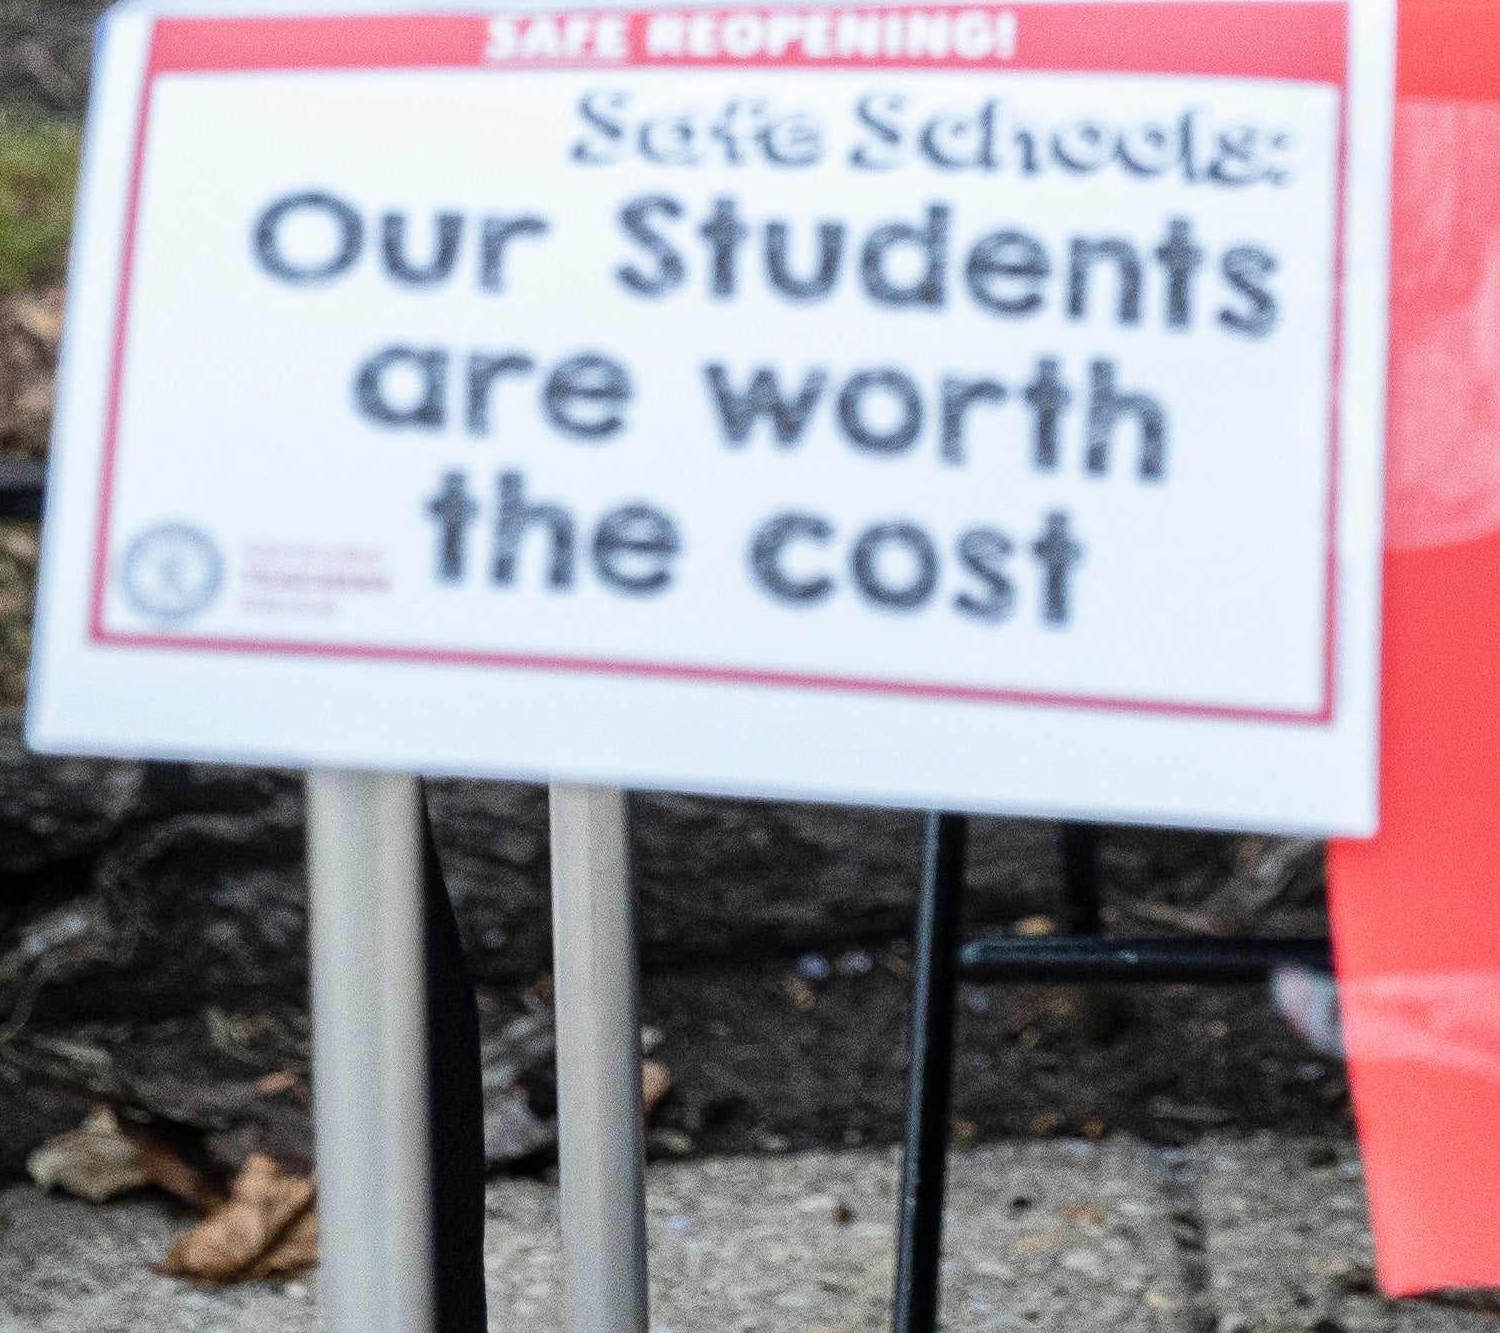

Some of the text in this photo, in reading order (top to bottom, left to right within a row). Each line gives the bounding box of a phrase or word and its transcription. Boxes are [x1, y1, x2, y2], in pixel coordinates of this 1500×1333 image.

[486, 10, 1019, 61] SAFE REOPENING!
[566, 89, 825, 171] Safe
[251, 189, 1279, 338] Our Students
[350, 343, 1169, 485] are worth
[425, 469, 1084, 628] the cost
